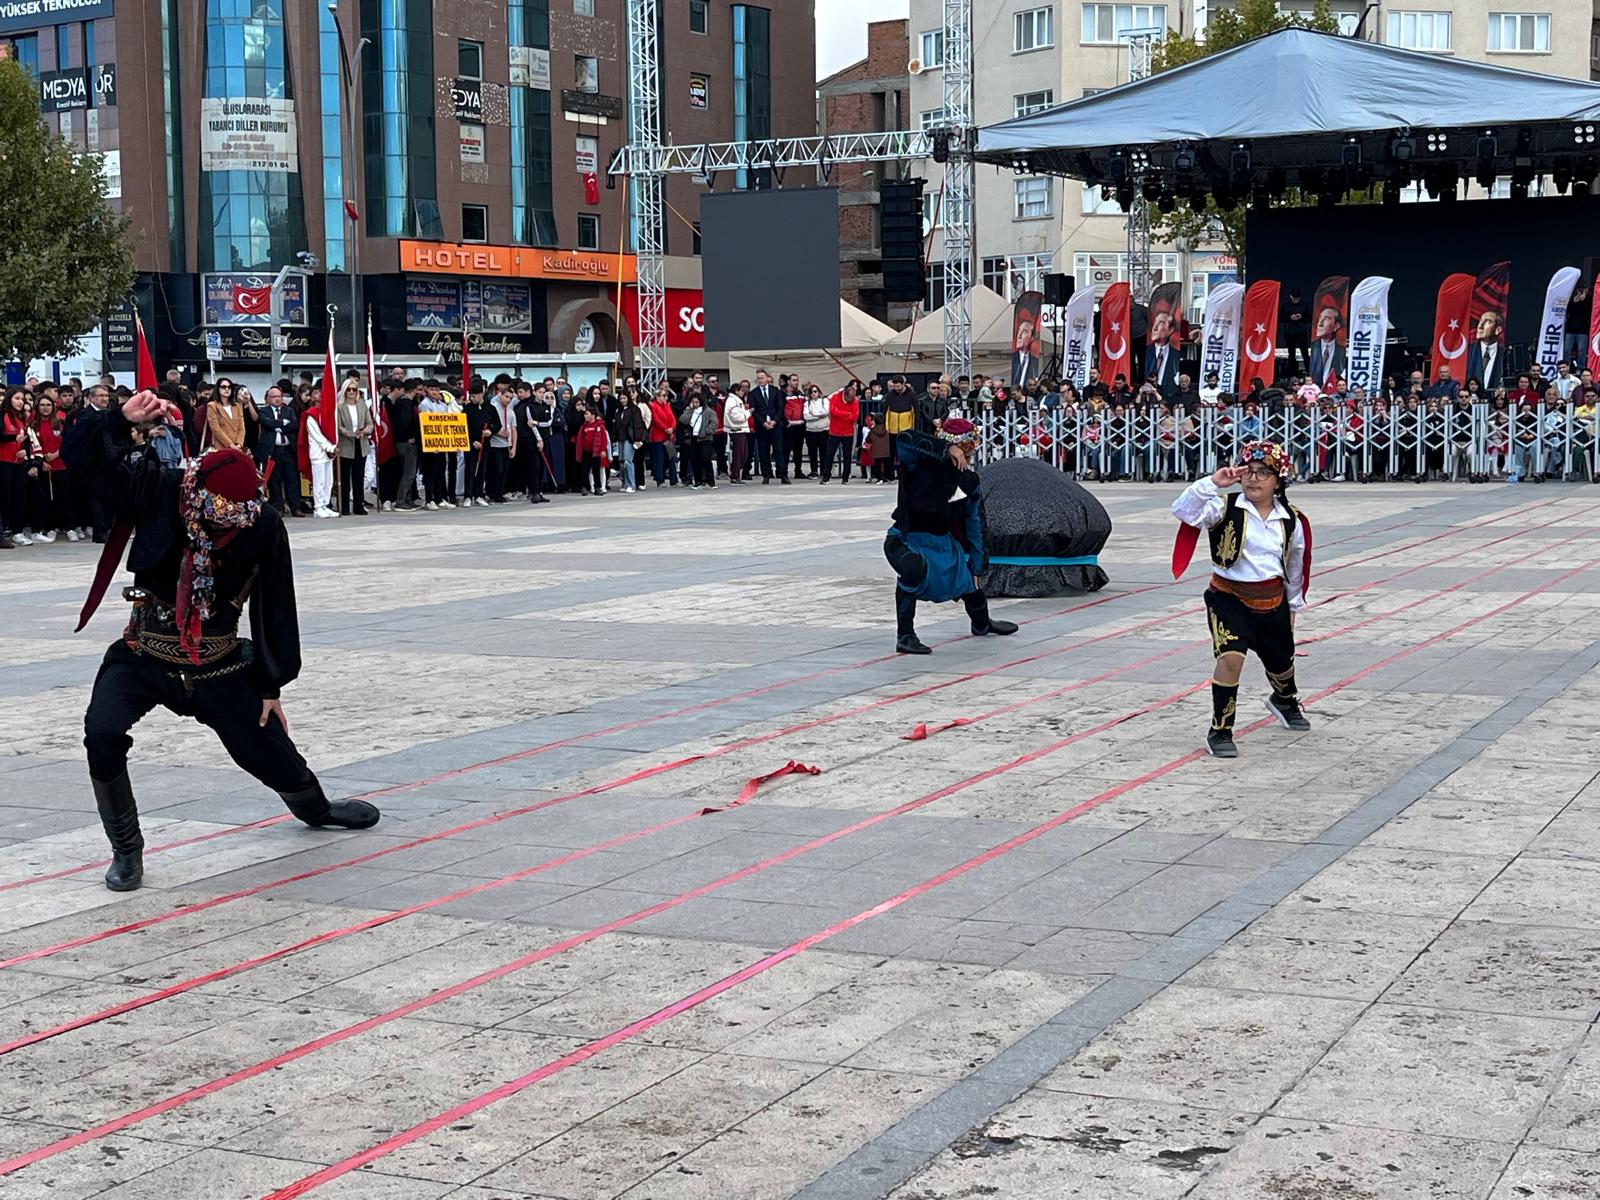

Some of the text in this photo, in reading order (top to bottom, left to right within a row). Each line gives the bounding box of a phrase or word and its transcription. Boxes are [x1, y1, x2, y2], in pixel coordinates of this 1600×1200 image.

[0, 1, 41, 18] YÜKSEK
[43, 77, 86, 99] MEDYA
[223, 104, 271, 115] ULUSLARARASI
[209, 118, 288, 133] YABANCI DİLLER KURUMU
[415, 248, 501, 270] HOTEL
[428, 414, 458, 422] KIRŞEHİR
[443, 424, 450, 435] VE
[425, 436, 468, 448] ANADOLU LİSESİ
